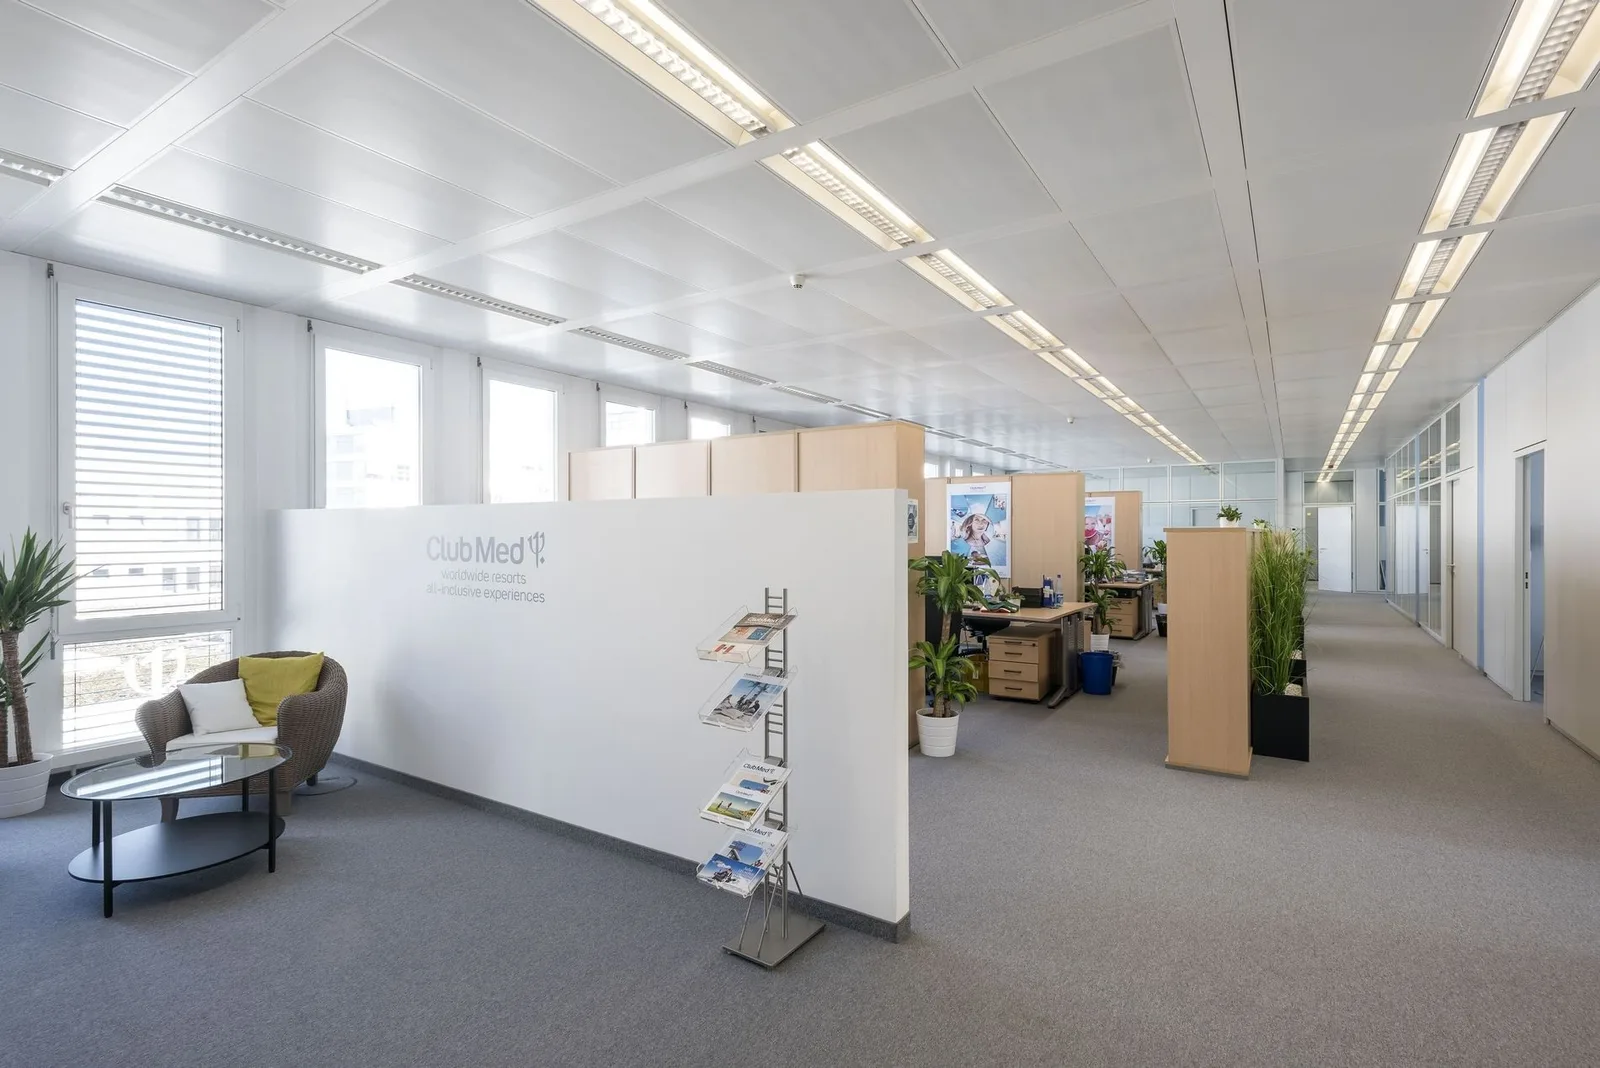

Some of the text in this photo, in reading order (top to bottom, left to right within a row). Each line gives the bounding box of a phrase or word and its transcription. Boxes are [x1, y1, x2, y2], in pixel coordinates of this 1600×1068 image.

[426, 534, 525, 564] Club Med
[440, 567, 527, 584] worldwide resorts
[426, 581, 545, 603] all-inclusive experiences
